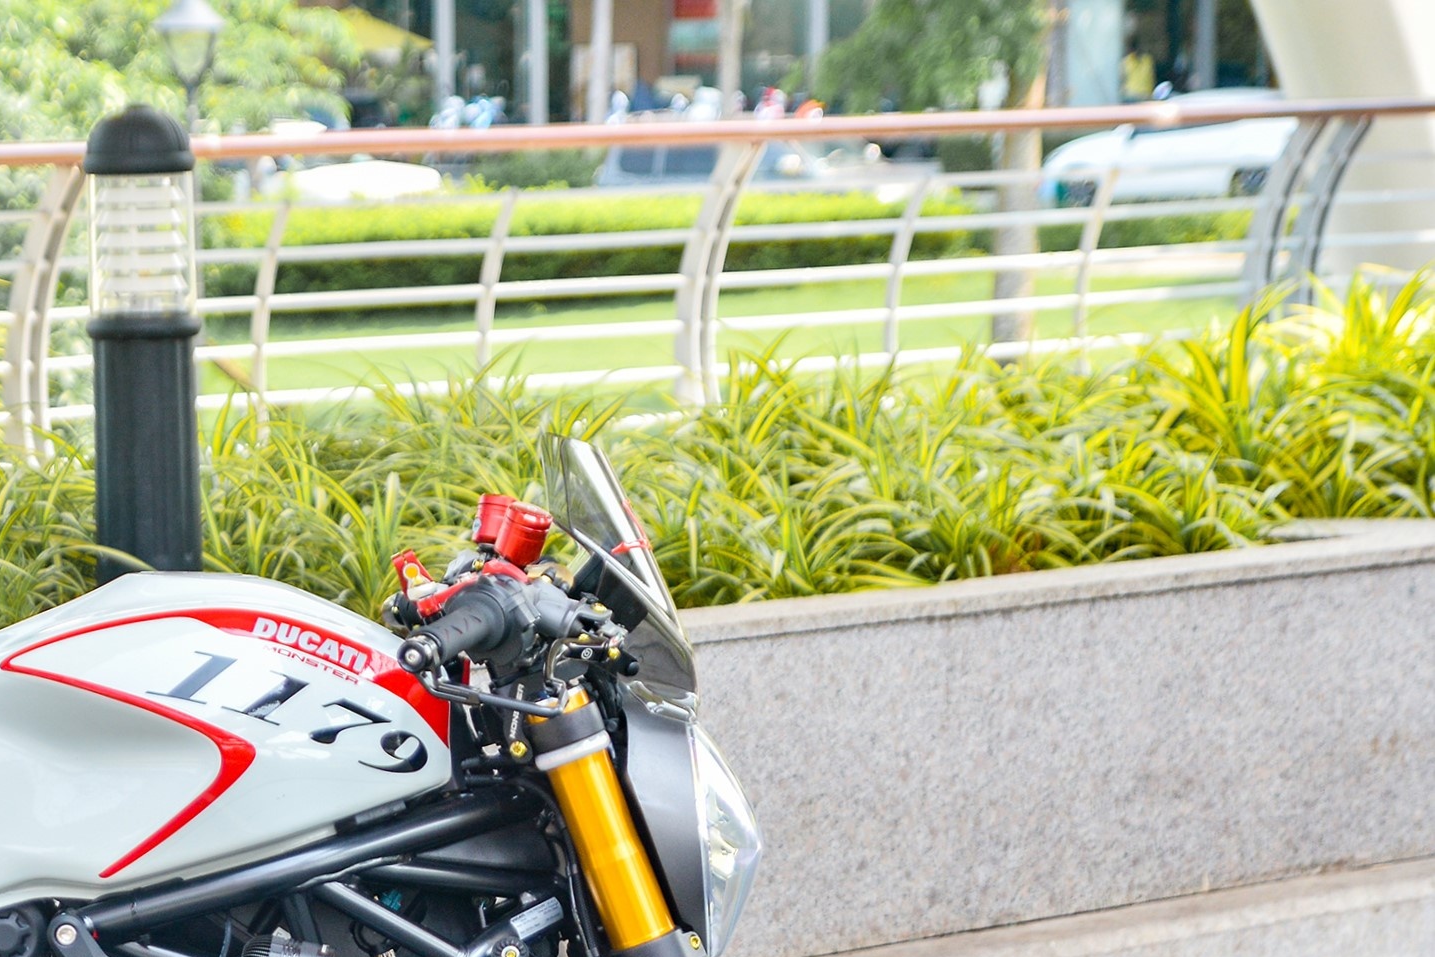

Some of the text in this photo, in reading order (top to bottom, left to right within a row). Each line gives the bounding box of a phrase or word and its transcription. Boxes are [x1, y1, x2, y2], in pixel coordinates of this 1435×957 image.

[251, 617, 369, 674] DUCATI
[262, 645, 361, 685] MONSTER
[145, 650, 429, 773] 1179
